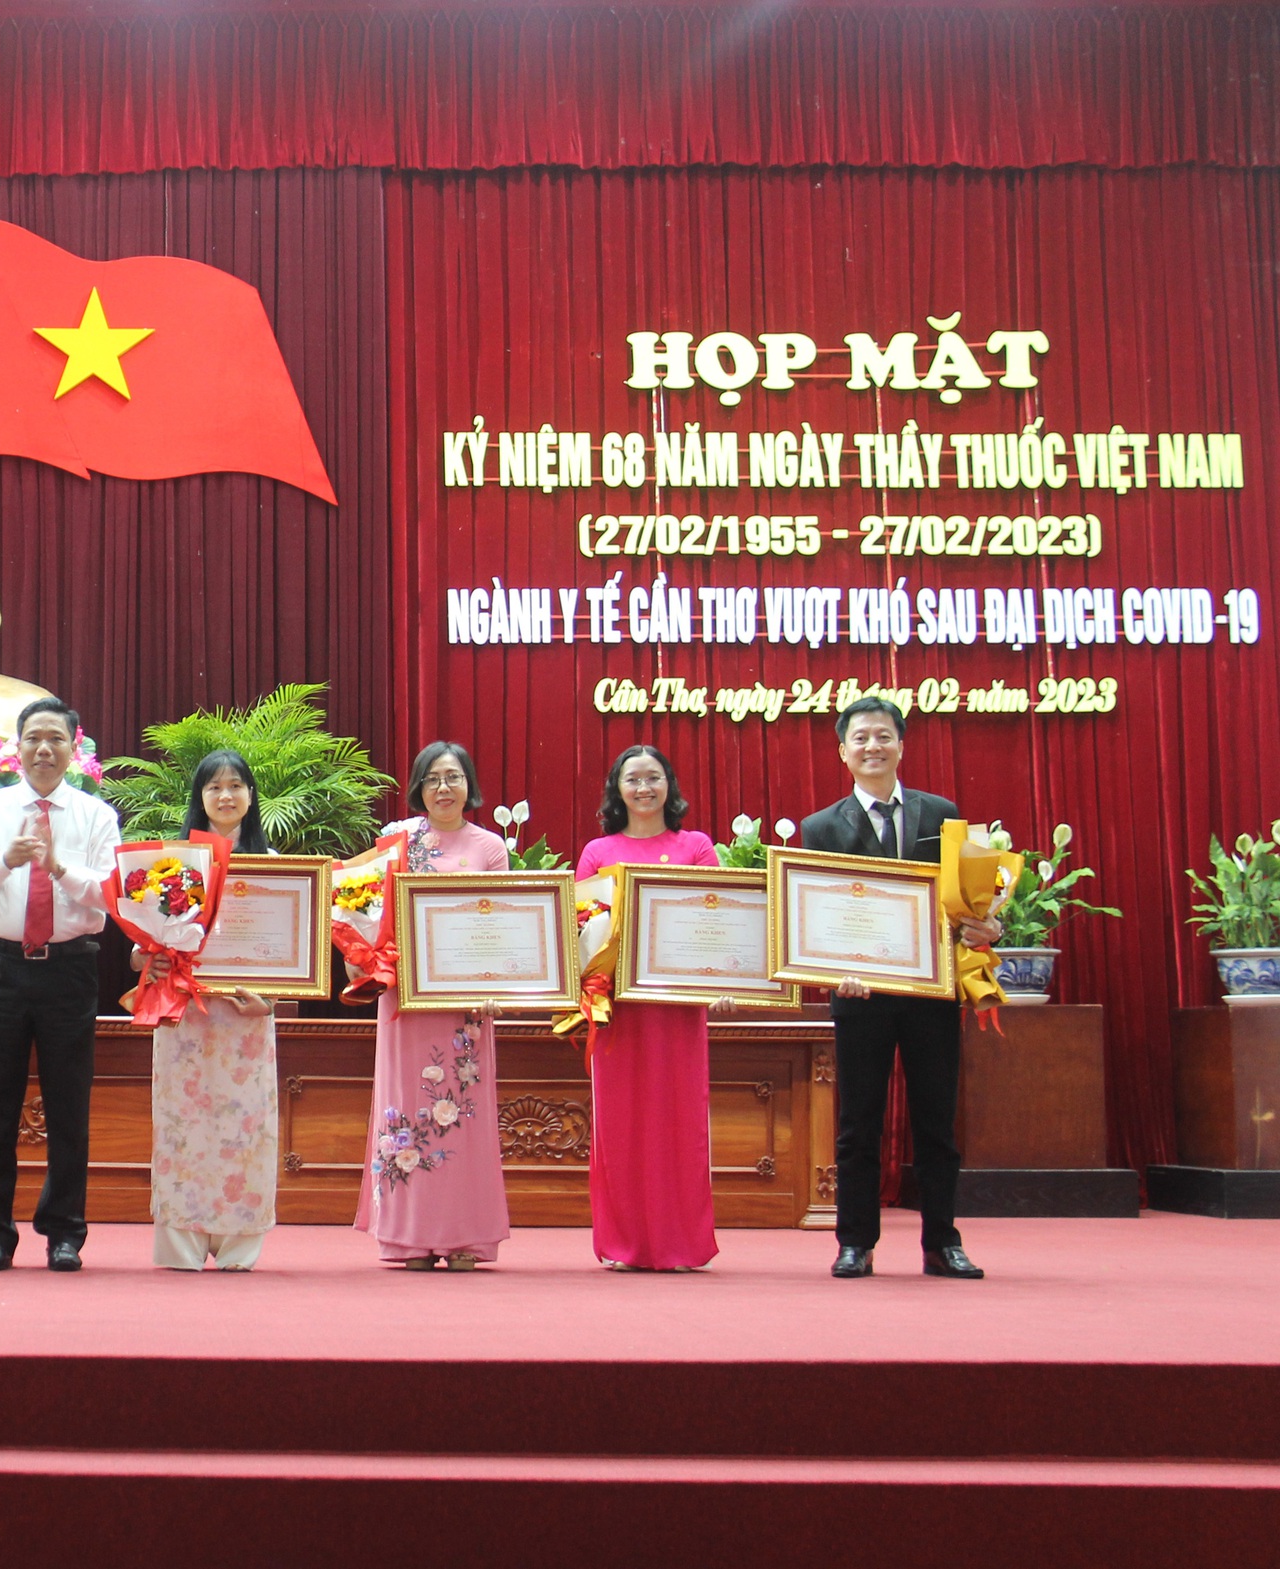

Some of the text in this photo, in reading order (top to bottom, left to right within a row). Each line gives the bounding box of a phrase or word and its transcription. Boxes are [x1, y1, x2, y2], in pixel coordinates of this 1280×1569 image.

[625, 311, 1050, 407] HỌP MẶT
[443, 415, 1244, 495] KỶ NIỆM 68 NĂM NGÀY THẦY THUỐC VIỆT NAM
[578, 513, 822, 559] (27/02/1955
[859, 513, 1103, 558] 27/02/2023)
[447, 570, 1260, 651] NGÀNH Y TẾ CẦN THƠ VƯỢT KHÓ SAU ĐẠI DỊCH COVID-19
[714, 681, 785, 722] ngày
[786, 678, 831, 714] 24
[917, 677, 960, 714] 02
[966, 680, 1030, 713] năm
[1034, 677, 1118, 714] 2023
